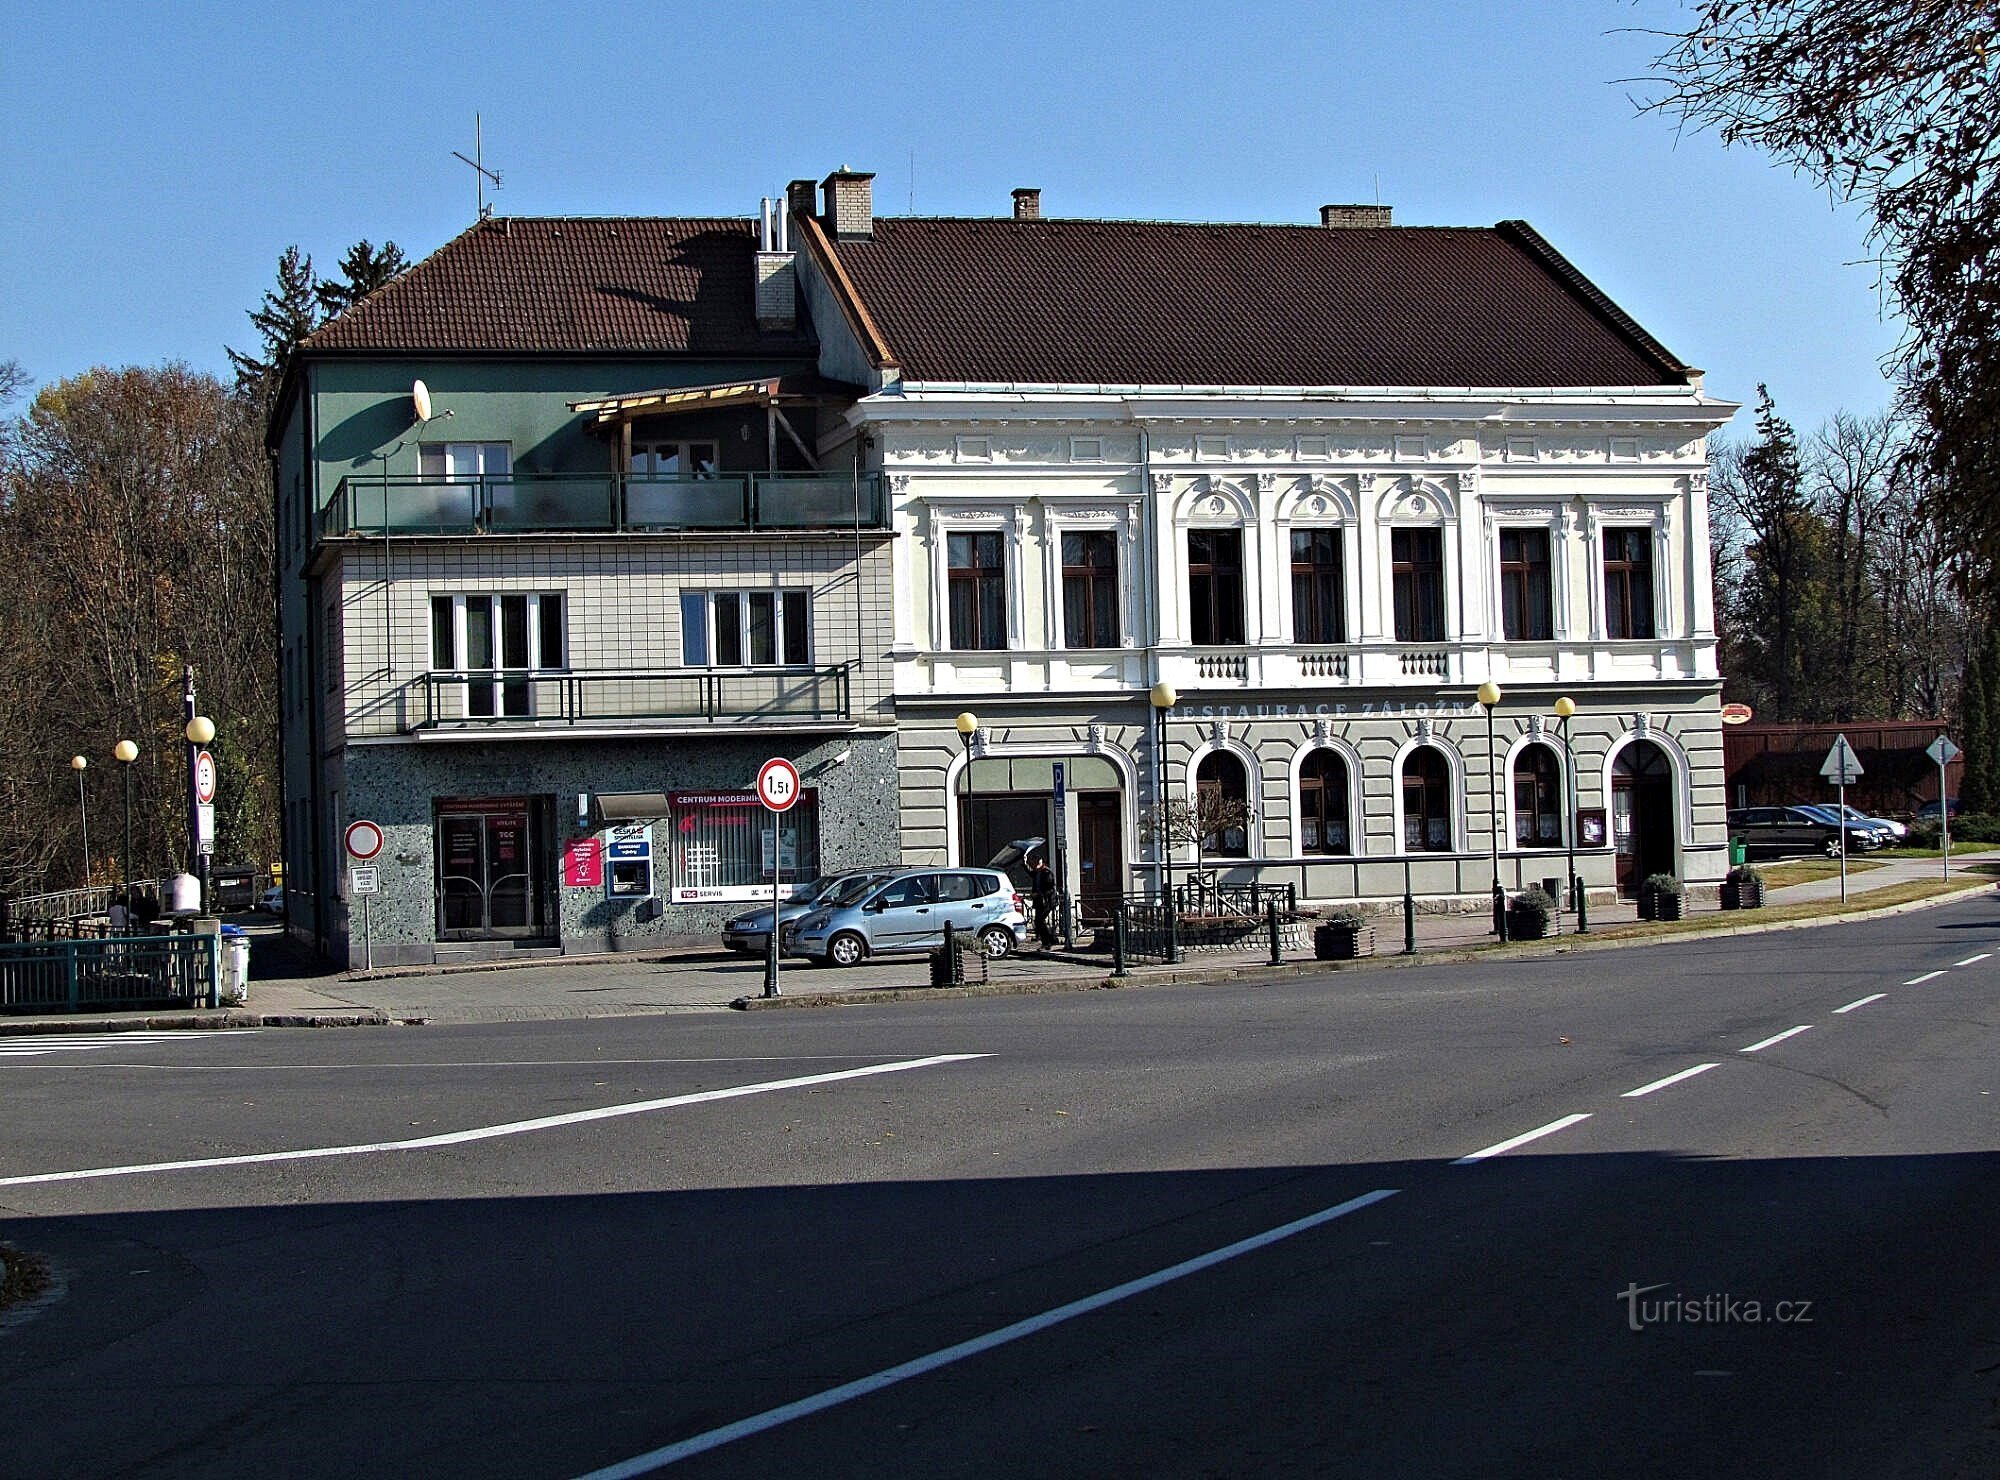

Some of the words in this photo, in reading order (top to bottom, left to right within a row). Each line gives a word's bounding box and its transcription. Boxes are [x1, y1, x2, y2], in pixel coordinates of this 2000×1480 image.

[1361, 700, 1488, 718] ZÁLOŽNA
[677, 796, 717, 804] CENTRUM
[717, 794, 760, 803] MODERNÍH
